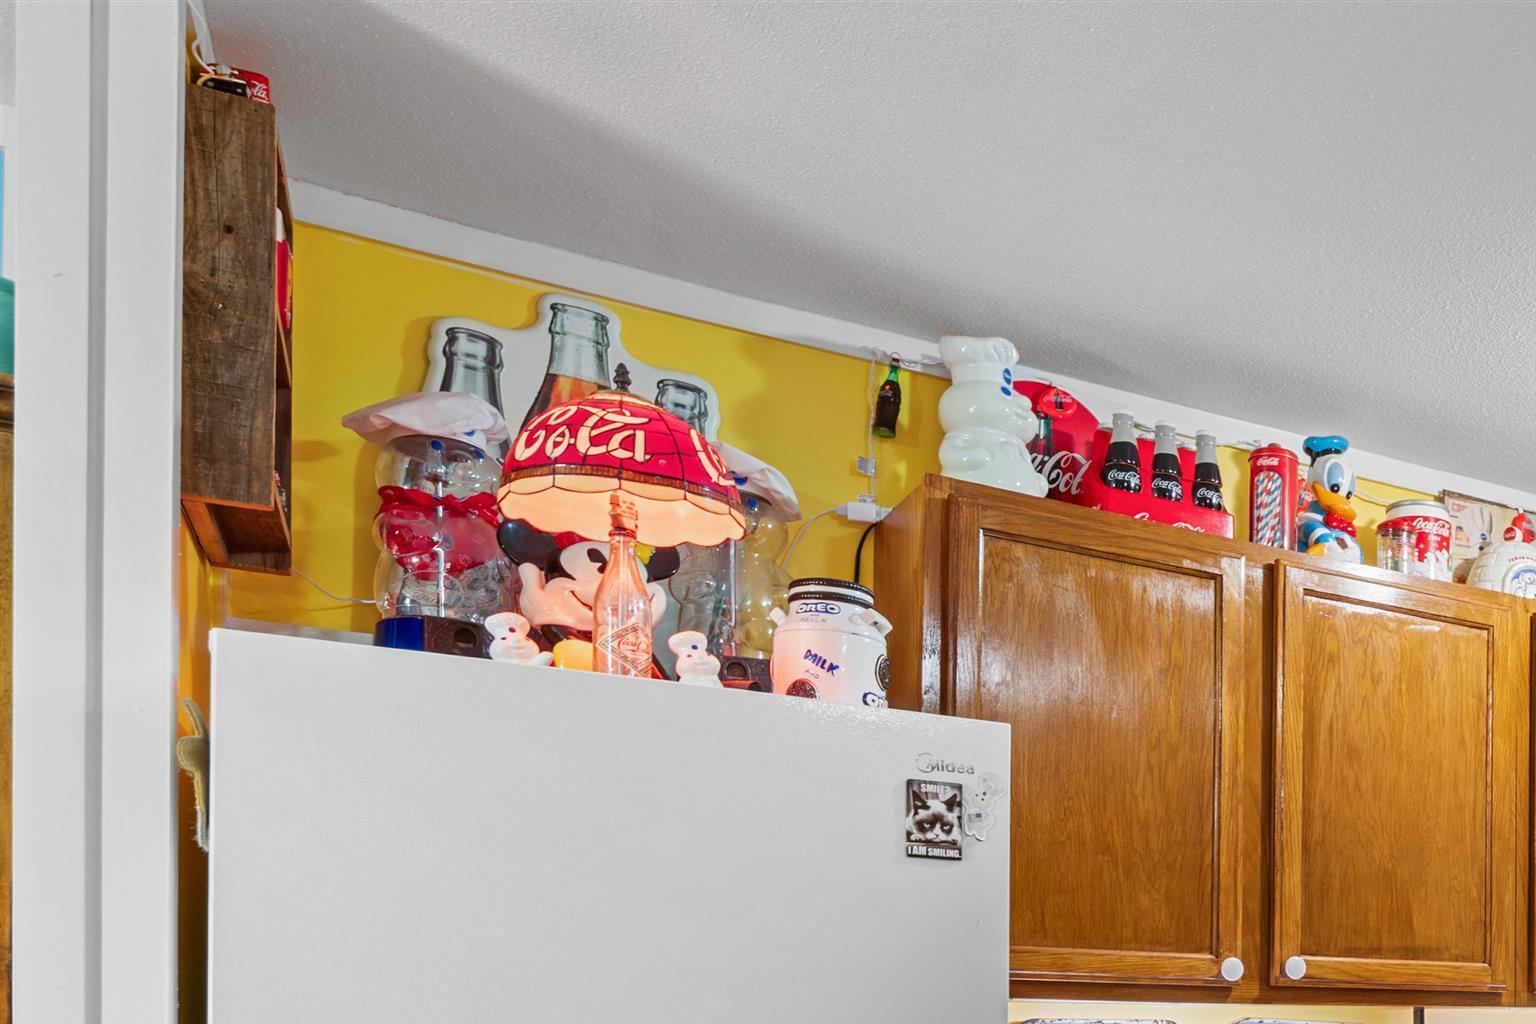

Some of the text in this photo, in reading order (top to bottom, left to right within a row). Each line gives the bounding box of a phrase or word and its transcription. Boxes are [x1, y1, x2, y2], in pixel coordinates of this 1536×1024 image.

[796, 602, 841, 614] OREO
[804, 649, 839, 677] MILK
[921, 784, 950, 794] SMILE?
[913, 845, 927, 856] AM
